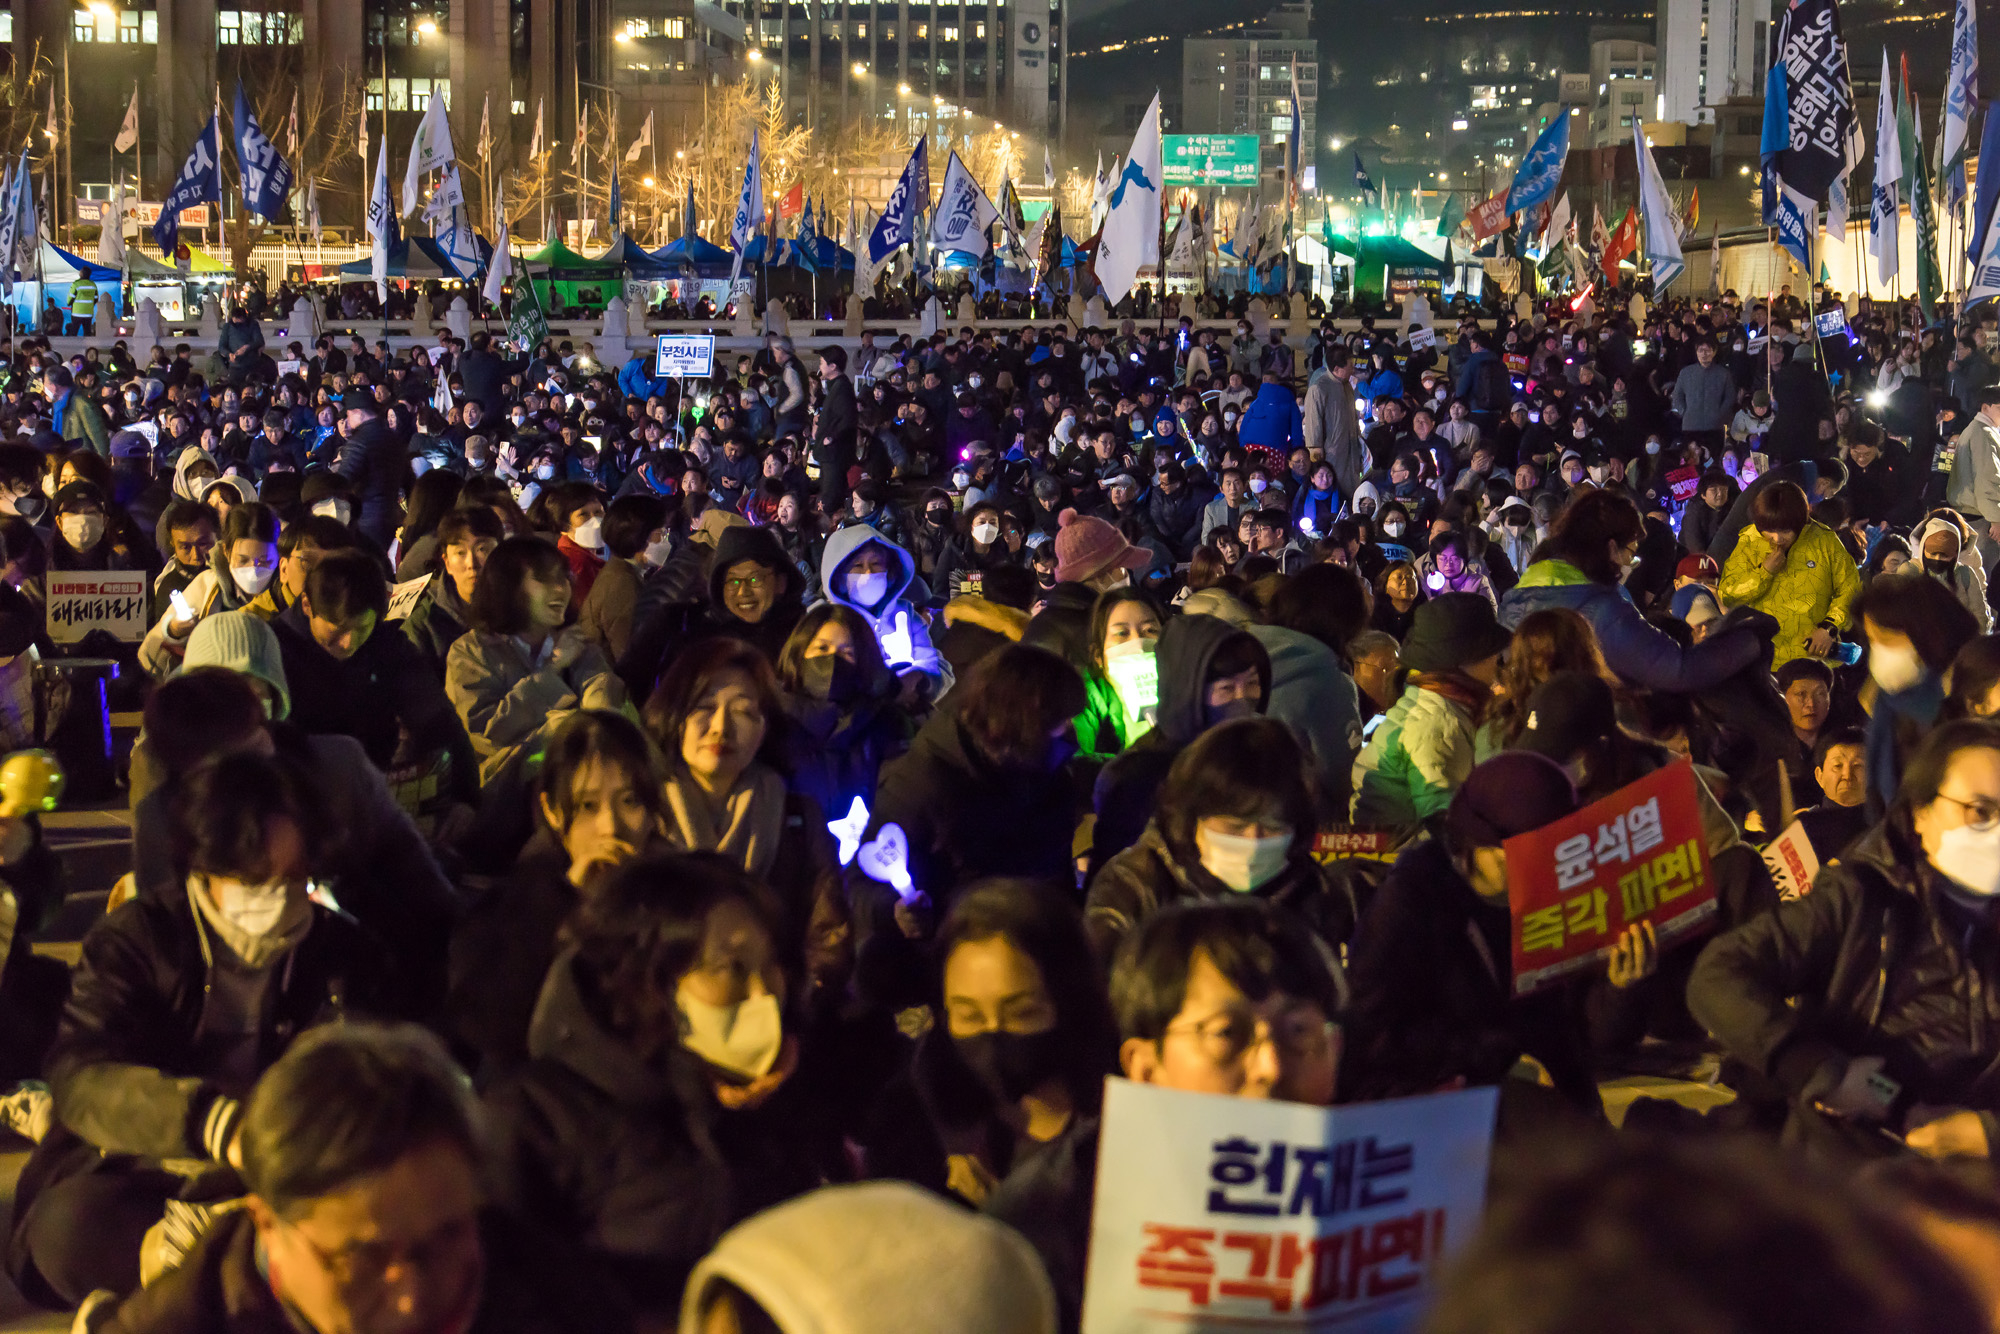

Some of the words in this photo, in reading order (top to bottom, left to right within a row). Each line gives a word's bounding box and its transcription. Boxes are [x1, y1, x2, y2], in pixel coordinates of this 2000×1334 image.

[1187, 137, 1209, 145] 수색역
[1187, 147, 1208, 155] 독립문
[1234, 165, 1254, 173] 효자동
[662, 346, 708, 358] 부천시을
[1698, 557, 1708, 569] N
[51, 597, 143, 627] 해체하라!
[1554, 796, 1664, 891] 윤석열
[1520, 887, 1609, 953] 즉각
[1618, 838, 1704, 922] 파면!
[1207, 1134, 1414, 1218] 헌재는
